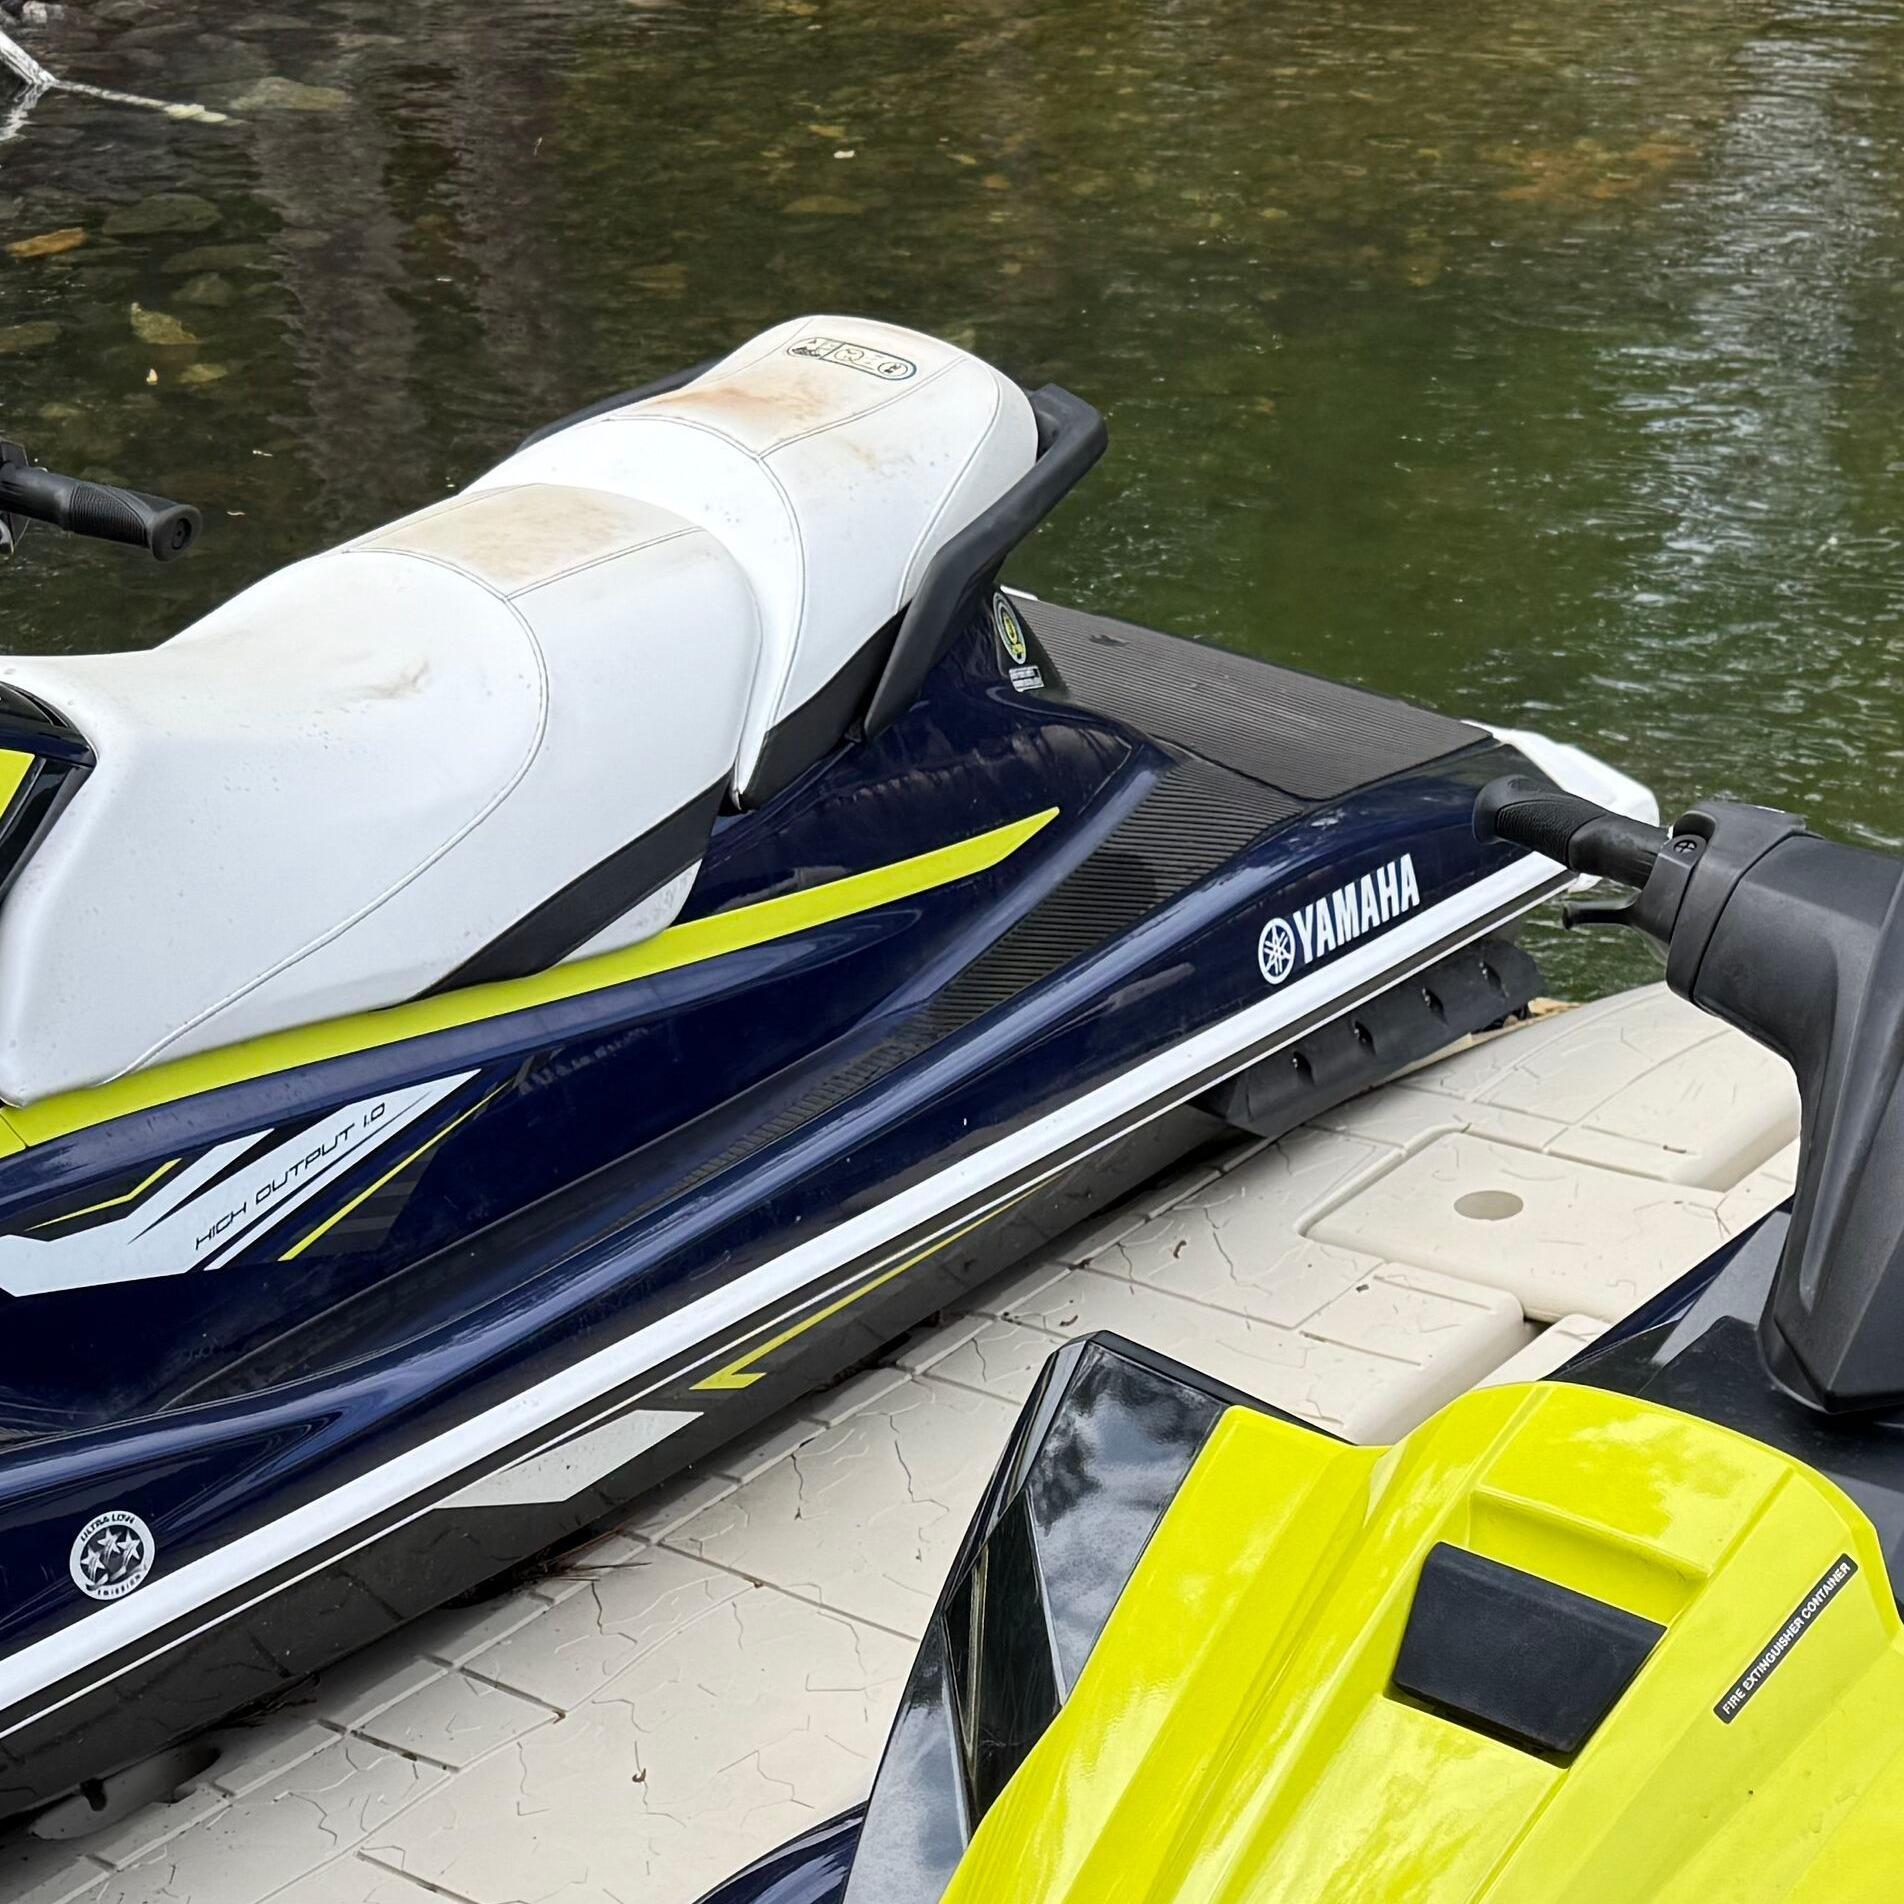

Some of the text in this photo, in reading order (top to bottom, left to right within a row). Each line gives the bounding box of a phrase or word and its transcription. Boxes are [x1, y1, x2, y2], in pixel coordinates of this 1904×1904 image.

[1293, 853, 1420, 964] YAMAHA
[196, 1102, 385, 1250] HIGH OUTPUT 1.0
[1722, 1562, 1851, 1714] FIRE EXTINGUISHER CONTAINER
